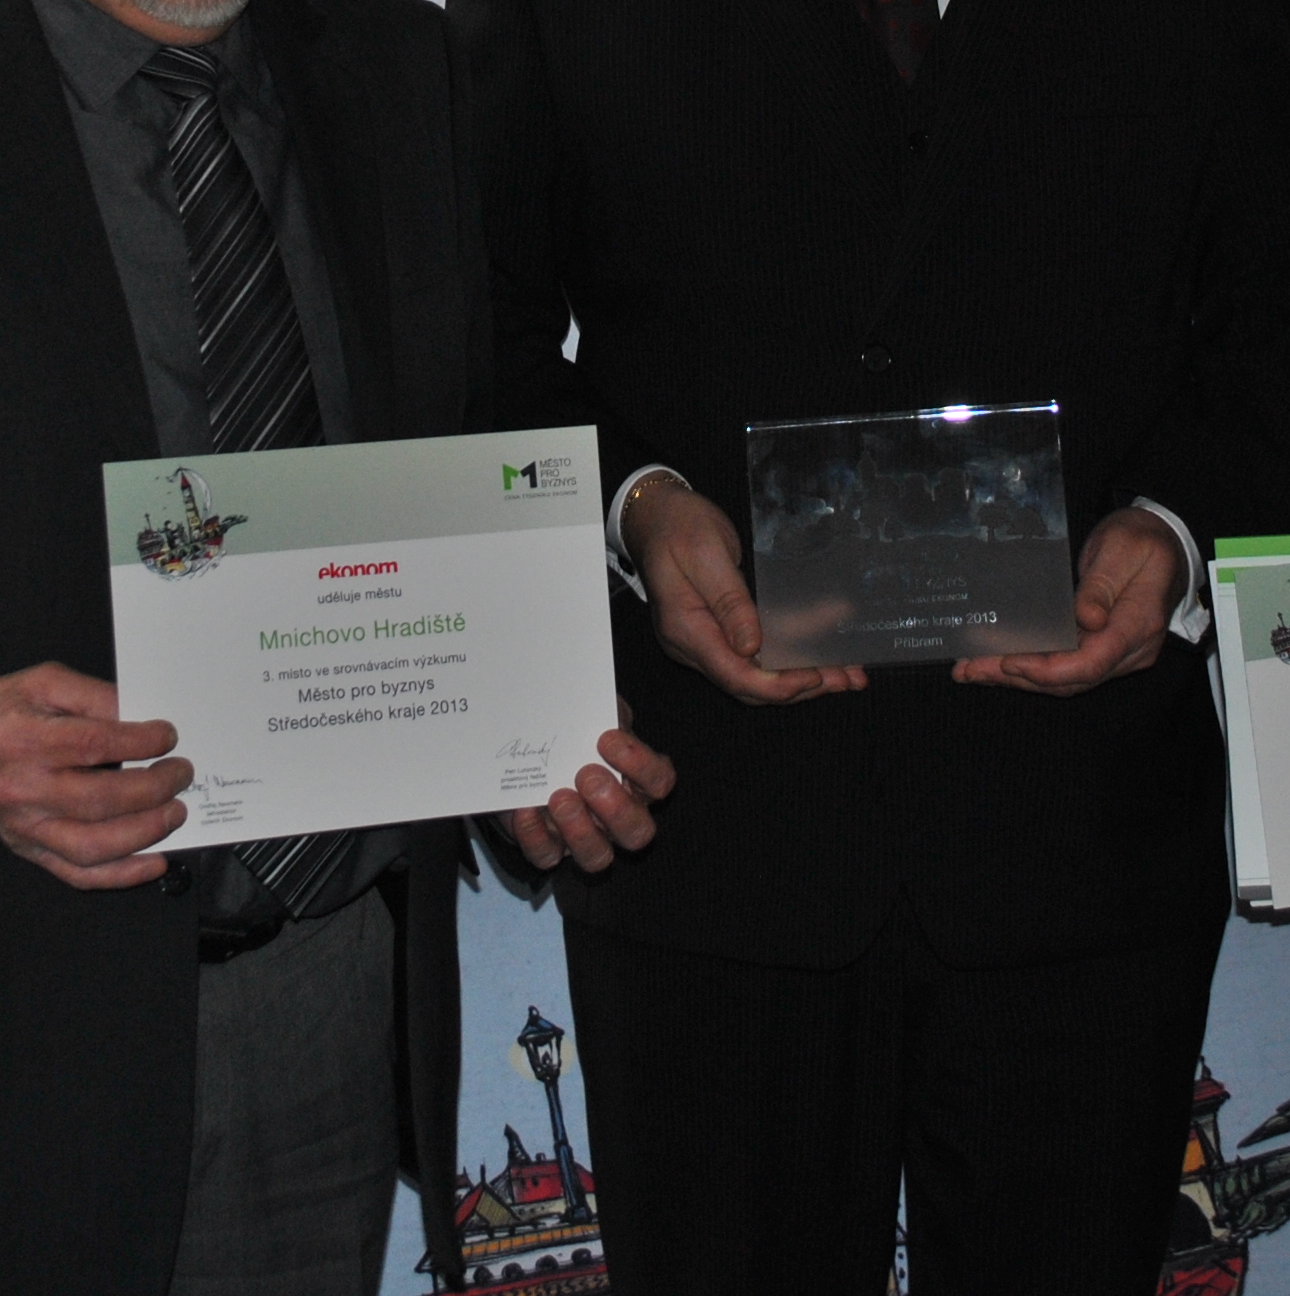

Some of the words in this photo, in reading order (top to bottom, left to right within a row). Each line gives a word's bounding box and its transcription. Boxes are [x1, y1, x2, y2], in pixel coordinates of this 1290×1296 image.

[539, 458, 571, 469] MĚSTO
[541, 468, 560, 478] PRO
[318, 561, 399, 579] ekonom
[317, 590, 361, 605] uděluje
[365, 587, 402, 600] městu
[932, 614, 963, 629] kraje
[966, 610, 998, 624] 2013
[259, 625, 366, 651] Mnichovo
[373, 612, 466, 639] Hradiště
[263, 670, 275, 682] 3.
[315, 667, 329, 677] ve
[333, 657, 409, 675] srovnávacím
[413, 652, 467, 669] výzkumu
[298, 686, 346, 703] Město
[351, 683, 376, 701] pro
[381, 678, 435, 697] byznys
[268, 708, 383, 733] Středočeského
[388, 703, 425, 721] kraje
[430, 697, 469, 715] 2013
